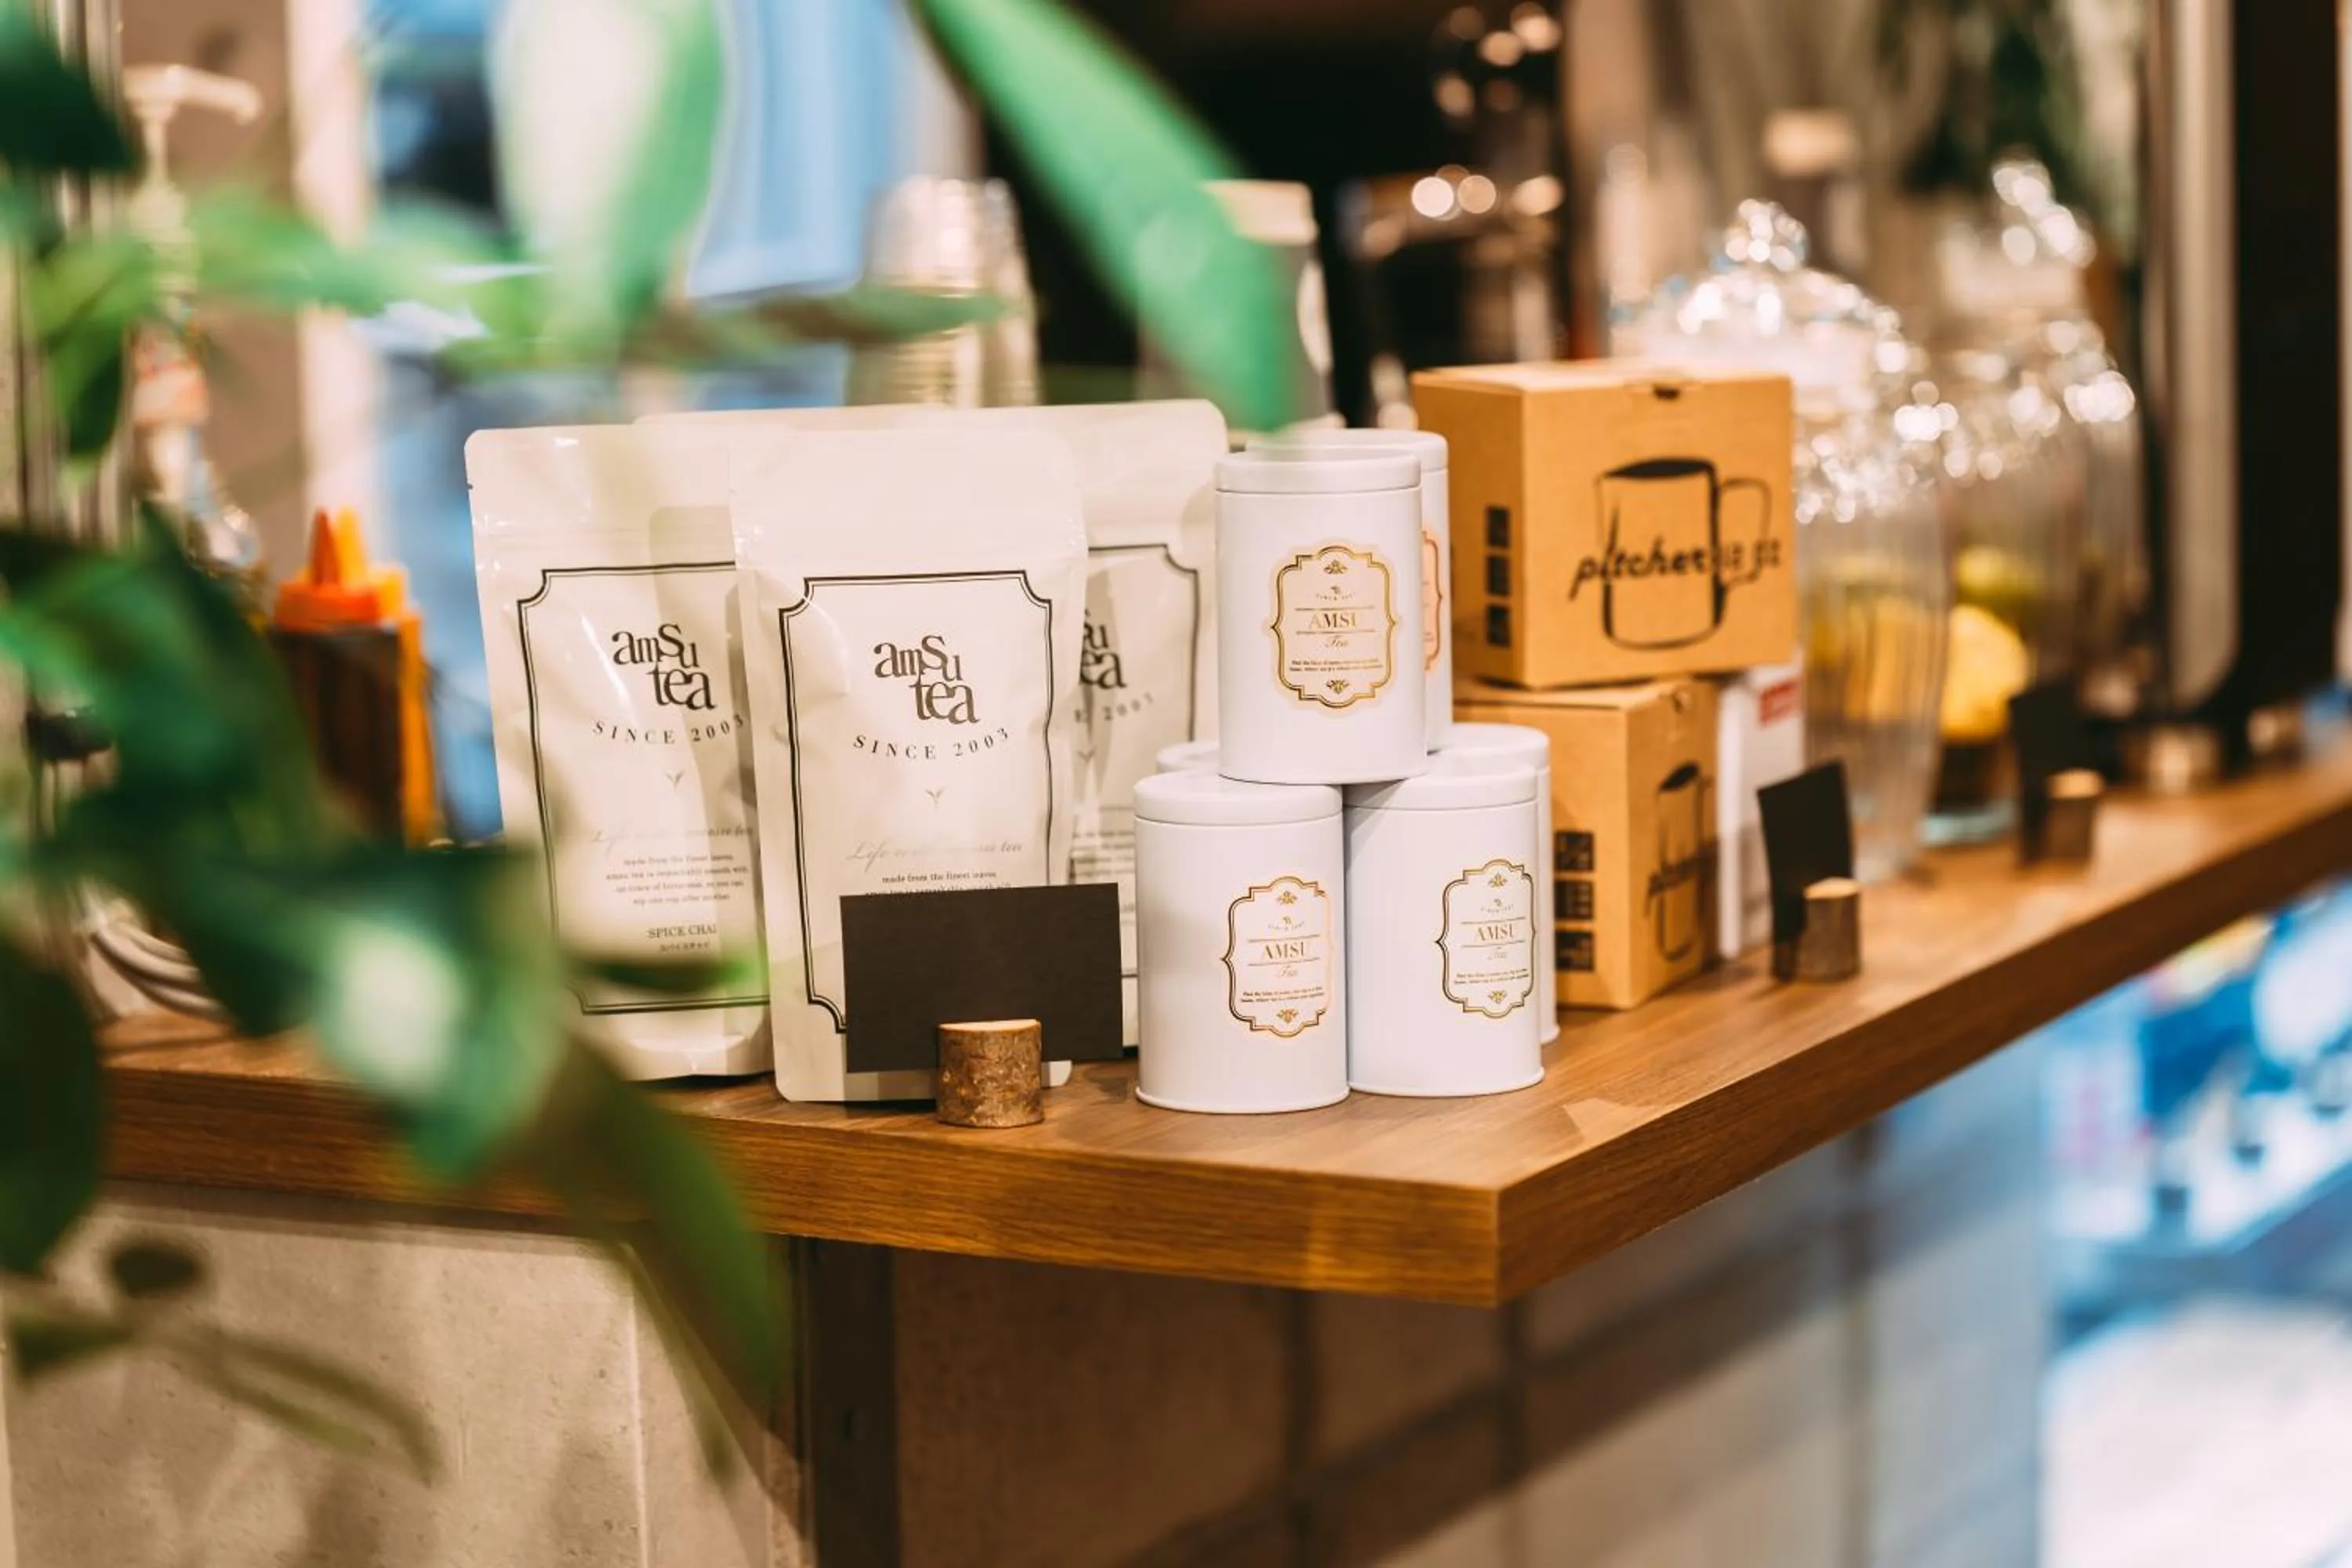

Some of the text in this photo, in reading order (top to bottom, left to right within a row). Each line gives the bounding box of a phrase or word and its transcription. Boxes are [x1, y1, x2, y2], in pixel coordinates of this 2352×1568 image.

[1568, 507, 1706, 601] pitcher
[646, 662, 717, 710] tea
[1080, 649, 1129, 691] ea
[909, 675, 981, 725] tea
[592, 713, 744, 745] SINCE 2003
[853, 726, 1011, 760] SINCE 2003
[647, 926, 688, 939] SPICE
